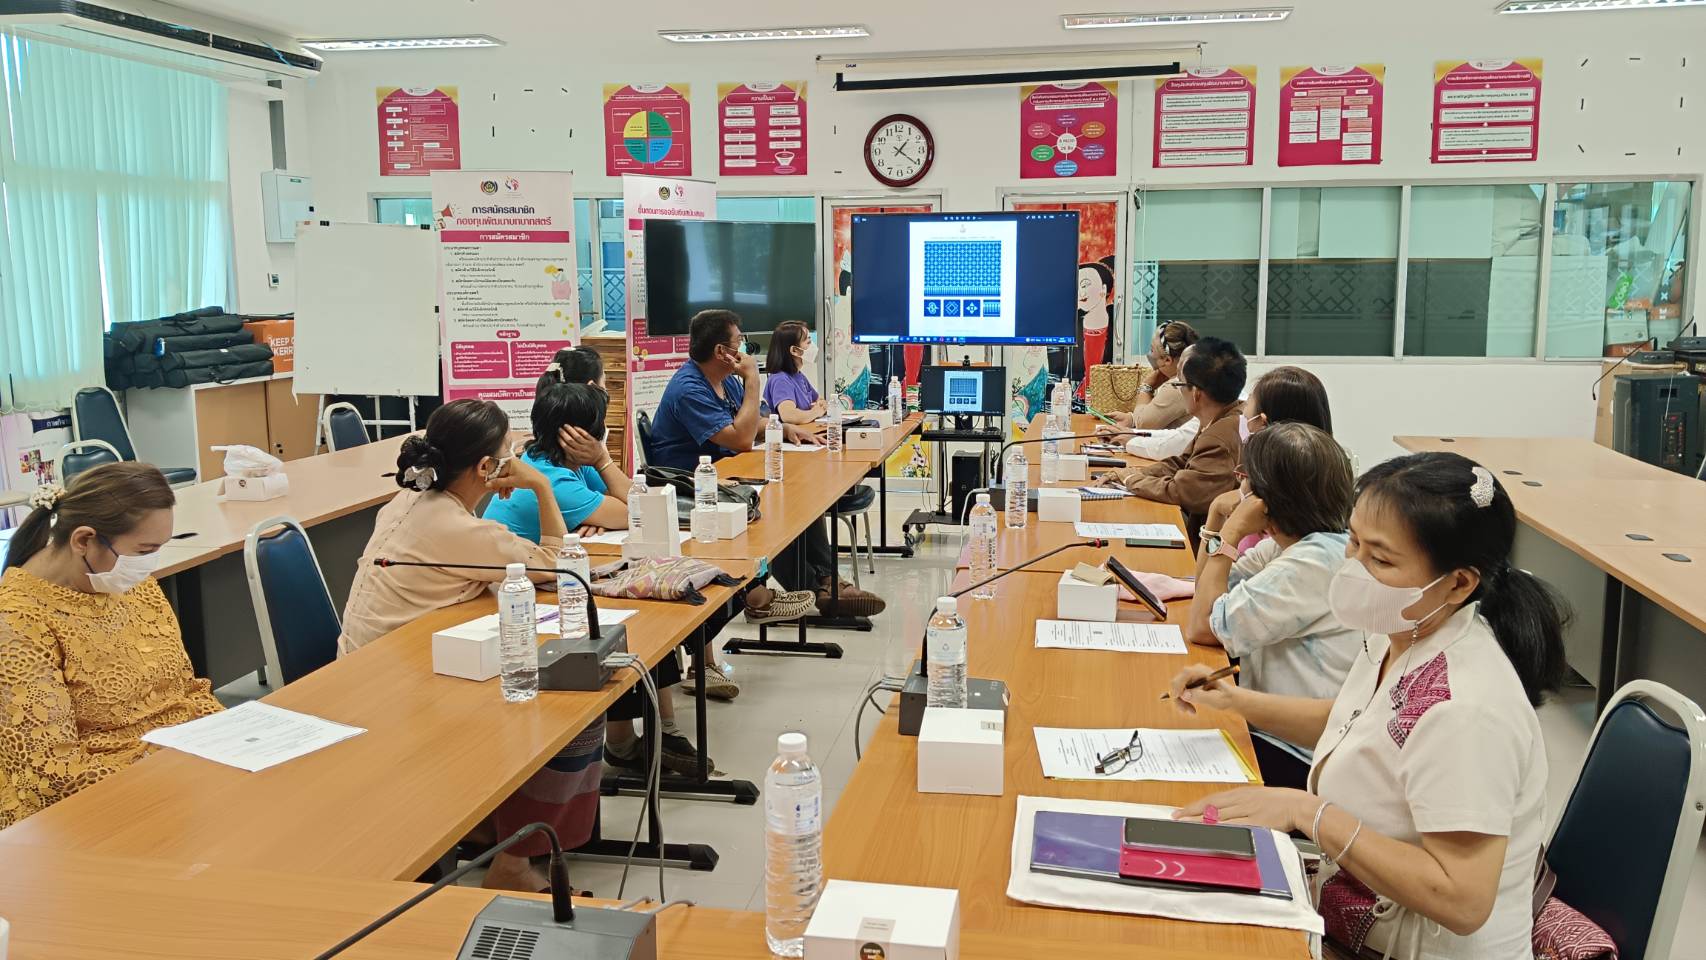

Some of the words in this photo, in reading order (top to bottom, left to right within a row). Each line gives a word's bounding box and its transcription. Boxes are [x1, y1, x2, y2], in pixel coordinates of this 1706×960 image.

[885, 128, 893, 137] 11
[894, 124, 904, 133] 12
[907, 127, 912, 136] 1
[877, 136, 886, 145] 10
[915, 135, 921, 143] 2
[874, 148, 881, 156] 9
[918, 146, 925, 154] 3
[877, 159, 884, 167] 8
[887, 167, 893, 175] 7
[896, 168, 904, 177] 6
[906, 166, 914, 174] 5
[472, 204, 535, 214] การสมัครสมาชิก
[456, 216, 552, 227] กองทุนพัฒนาบทบาทสตรี
[479, 232, 530, 241] การสมัครสมาชิก
[270, 338, 290, 346] KEEP
[274, 346, 293, 356] KERR
